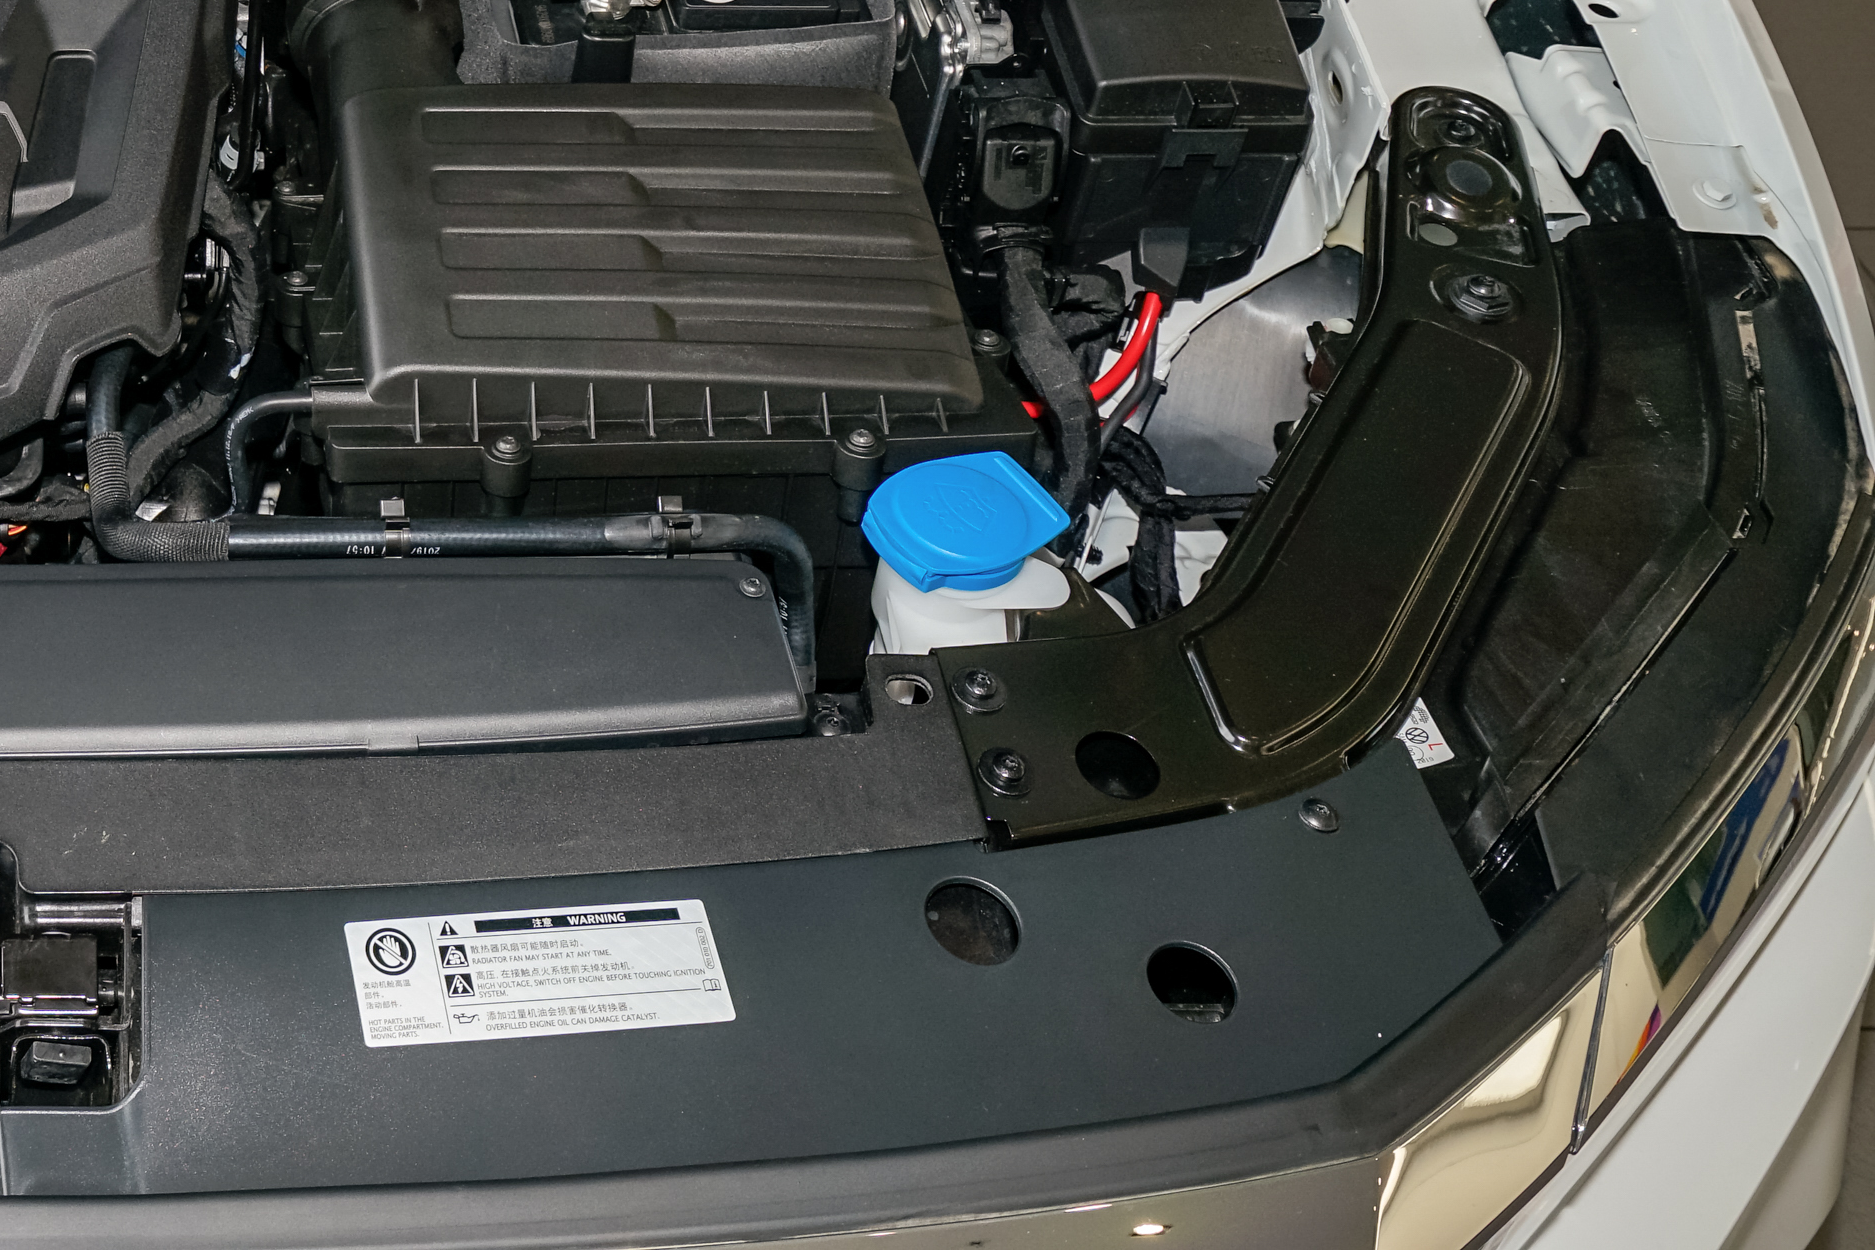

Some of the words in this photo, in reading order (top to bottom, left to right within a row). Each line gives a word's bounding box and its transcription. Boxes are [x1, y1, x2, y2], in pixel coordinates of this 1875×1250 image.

[531, 917, 554, 928] 注意
[567, 912, 627, 925] WARNING
[472, 955, 508, 965] RADIATOR
[509, 954, 524, 963] FAN
[525, 953, 541, 962] MAY
[543, 952, 564, 961] START
[566, 951, 575, 960] AT
[577, 950, 591, 959] ANY
[593, 949, 612, 958] TIME.
[477, 981, 496, 991] HIGH
[533, 978, 562, 988] SWITCH
[564, 977, 579, 986] OFF
[580, 975, 606, 985] ENGINE
[607, 973, 633, 983] BEFORE
[634, 970, 671, 981] TOUCHING
[673, 968, 706, 978] IGNITION
[478, 989, 510, 999] SYSTEM.
[383, 1017, 402, 1025] PARTS
[486, 1021, 528, 1031] OVERFILLED
[529, 1019, 554, 1029] ENGINE
[555, 1018, 569, 1027] OIL
[570, 1017, 588, 1027] CAN
[589, 1015, 619, 1025] DAMAGE
[620, 1012, 661, 1023] CATALYST.
[369, 1025, 392, 1033] ENGINE
[393, 1022, 444, 1032] COMPARTMENT.
[371, 1032, 397, 1040] MOVING
[398, 1031, 420, 1039] PARTS.
